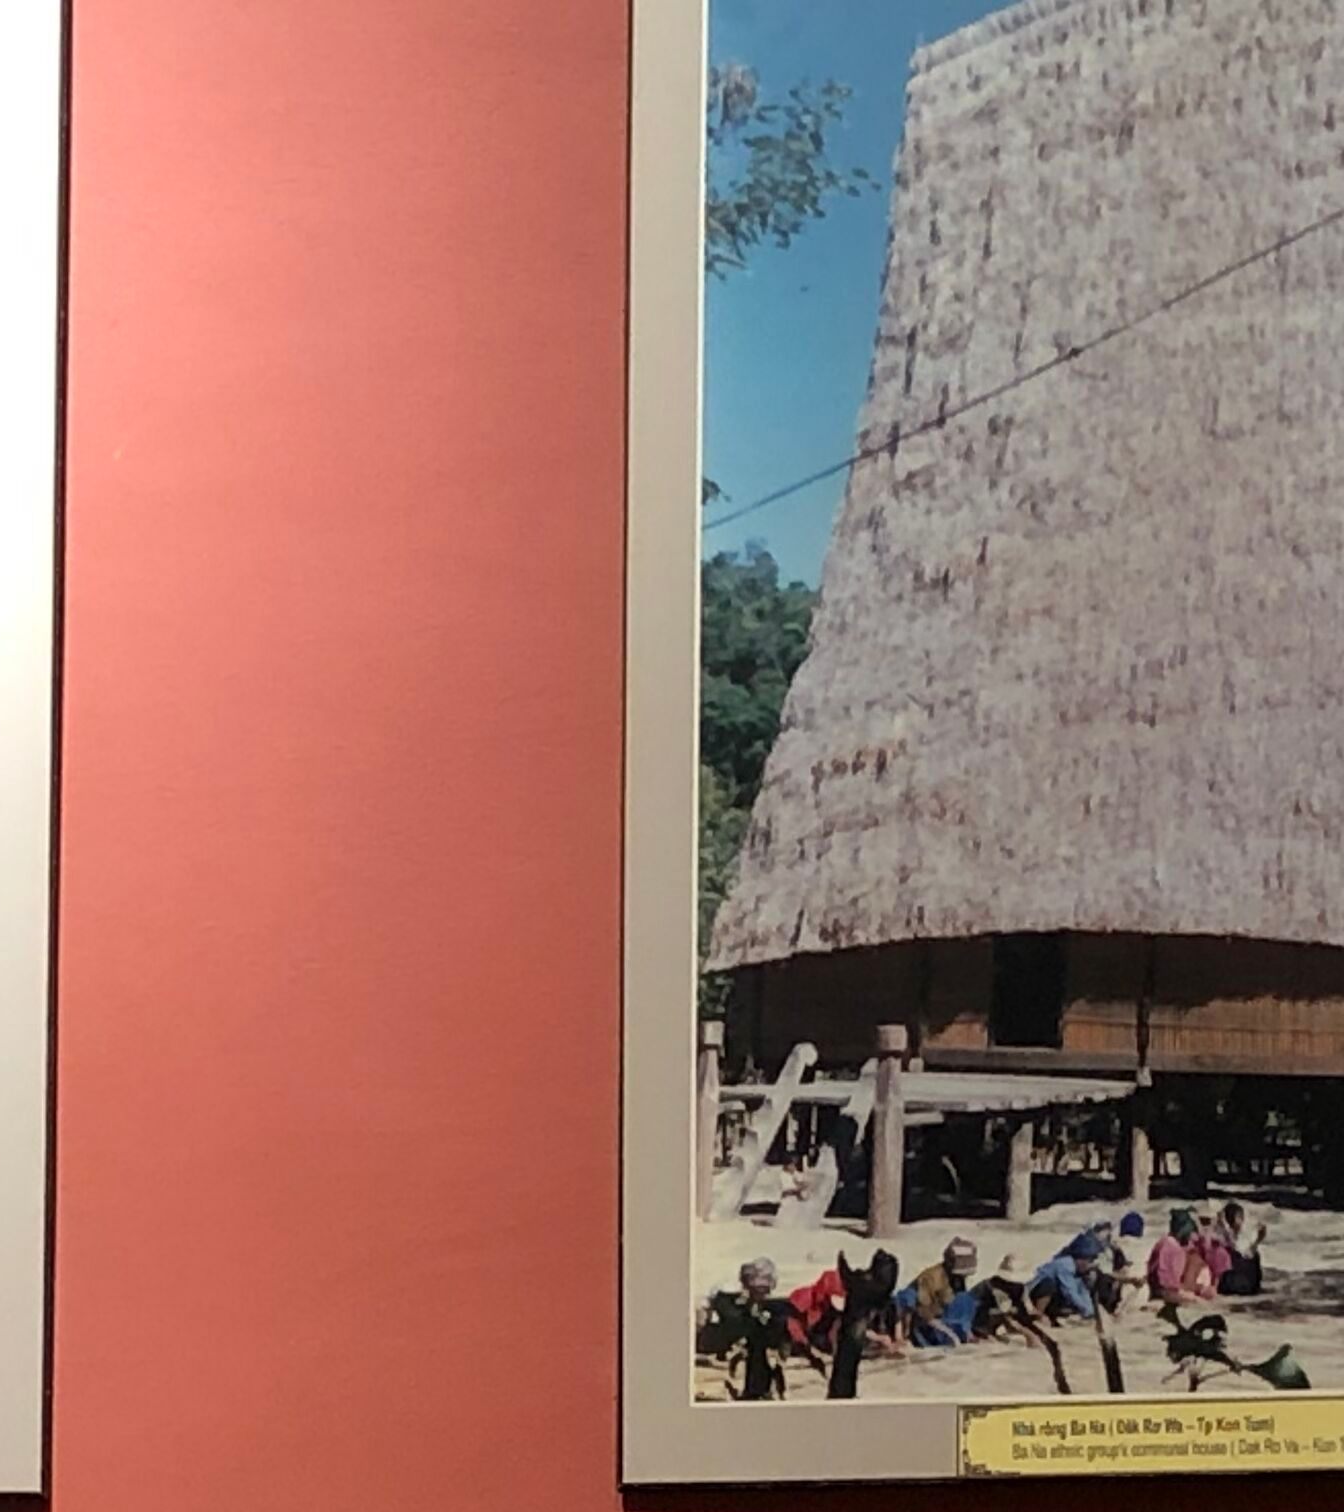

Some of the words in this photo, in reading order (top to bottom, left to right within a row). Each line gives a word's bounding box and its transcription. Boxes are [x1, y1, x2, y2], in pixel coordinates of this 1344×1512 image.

[1012, 1421, 1035, 1436] Nhà
[1089, 1420, 1105, 1435] Na
[1197, 1416, 1212, 1435] Tp
[1216, 1417, 1240, 1432] Kon
[1243, 1415, 1275, 1433] Tum)
[1050, 1444, 1083, 1458] ethnic
[1131, 1443, 1189, 1458] communal
[1193, 1441, 1227, 1455] house
